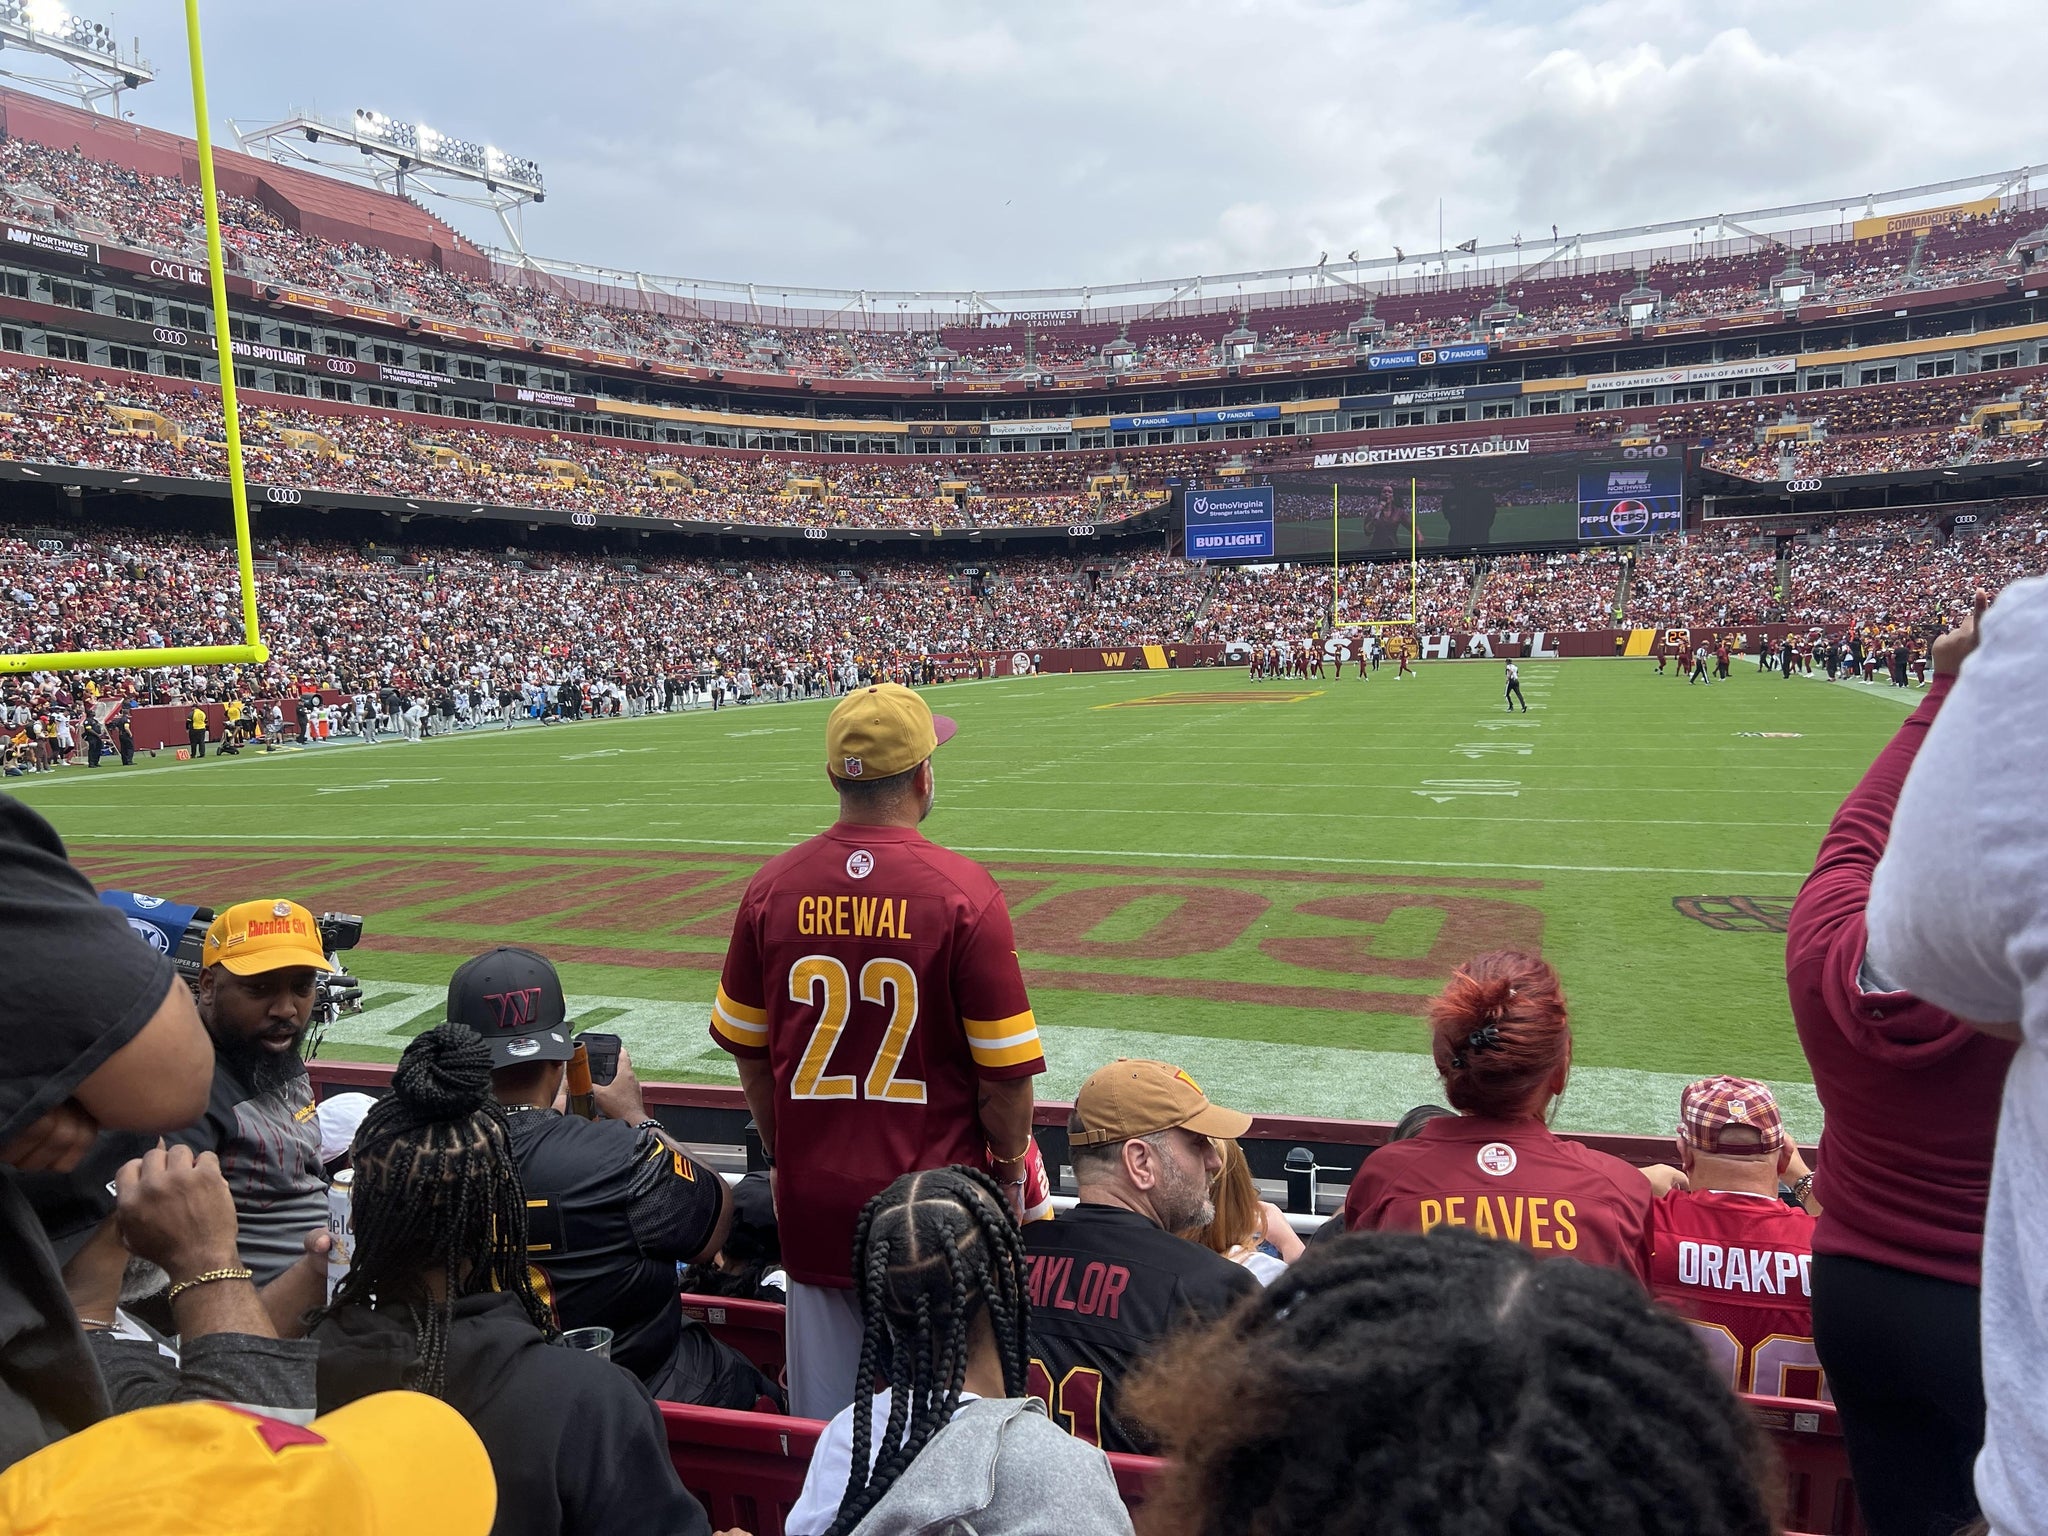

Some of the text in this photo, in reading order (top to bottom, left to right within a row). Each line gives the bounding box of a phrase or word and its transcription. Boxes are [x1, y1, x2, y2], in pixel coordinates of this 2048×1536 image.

[33, 233, 89, 252] NORTHWEST
[150, 260, 184, 280] CACI
[1014, 310, 1078, 320] NORTHWEST
[212, 338, 306, 365] LEND SPOTLIGHT
[1451, 349, 1485, 358] FANDUEL
[1381, 355, 1415, 365] FANDUEL
[1421, 352, 1434, 362] 25
[1730, 366, 1770, 376] AMERICA
[1627, 376, 1665, 386] AMERICA
[535, 392, 576, 404] NORTHWEST
[1414, 388, 1465, 399] NORTHWEST
[1226, 411, 1255, 419] FANDUEL
[1141, 417, 1170, 425] FANDUEL
[1342, 446, 1446, 463] NORTHWEST
[1450, 439, 1529, 456] STADIUM
[1623, 445, 1668, 459] 0:10
[1607, 484, 1652, 492] NORTHWEST
[1209, 500, 1263, 510] OrthoVirginia
[1580, 515, 1609, 524] PEPSI
[1613, 513, 1646, 523] PEPSI
[1651, 511, 1681, 520] PEPSI
[1196, 534, 1263, 548] BUD LIGHT
[797, 895, 911, 939] GREWAL
[248, 918, 290, 938] Chocolate
[191, 960, 201, 968] 95
[788, 954, 927, 1104] 22
